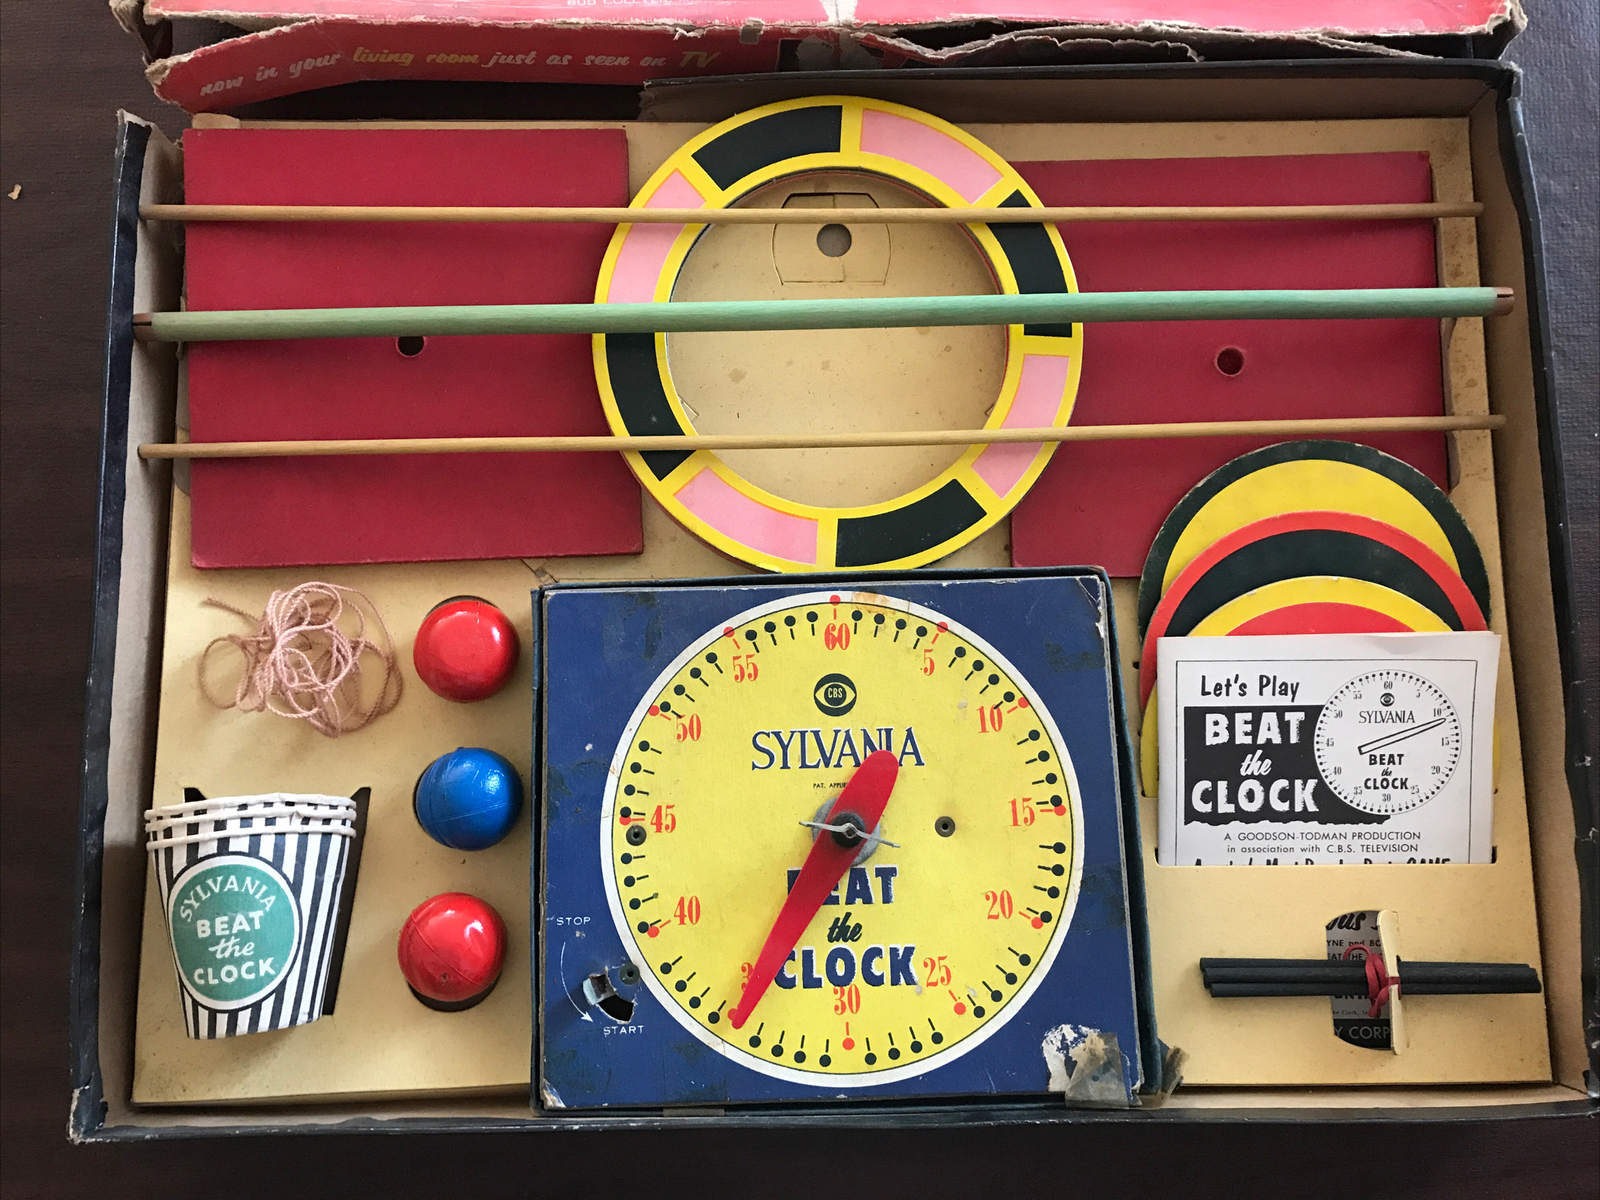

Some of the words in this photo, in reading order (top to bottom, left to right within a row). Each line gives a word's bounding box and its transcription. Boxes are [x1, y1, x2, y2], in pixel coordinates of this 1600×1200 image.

[200, 76, 243, 96] now
[256, 65, 278, 82] in
[289, 51, 342, 79] your
[353, 46, 415, 67] living
[426, 52, 480, 64] room
[481, 51, 538, 68] just
[546, 54, 573, 66] as
[585, 53, 631, 67] seen
[640, 55, 667, 67] on
[678, 51, 721, 69] TV
[824, 622, 850, 651] 60
[732, 653, 759, 684] 55
[923, 648, 935, 676] 5
[827, 687, 844, 699] CBS
[1200, 673, 1247, 698] Let's
[1259, 674, 1300, 702] Play
[1353, 690, 1362, 700] 55
[1383, 681, 1393, 690] 60
[1416, 689, 1421, 698] 5
[976, 704, 1003, 734] 10
[1334, 710, 1343, 719] 50
[1359, 710, 1416, 724] SYLVANIA
[1433, 707, 1442, 717] 10
[676, 714, 702, 743] 50
[1205, 711, 1306, 746] BEAT
[752, 726, 926, 771] SYLVANIA
[1325, 737, 1335, 747] 45
[1441, 737, 1450, 747] 15
[1240, 750, 1272, 776] the
[1333, 766, 1342, 775] 40
[1369, 753, 1405, 766] BEAT
[1431, 765, 1441, 775] 20
[1364, 778, 1409, 790] CLOCK
[1381, 767, 1392, 777] the
[812, 782, 826, 790] PAT.
[1191, 779, 1319, 814] CLOCK
[1353, 786, 1363, 796] 35
[1382, 793, 1391, 803] 30
[1410, 785, 1420, 795] 25
[650, 804, 676, 833] 45
[1008, 797, 1035, 827] 15
[1224, 832, 1232, 841] A
[1238, 831, 1348, 841] GOODSON-TODMAN
[1352, 831, 1421, 840] PRODUCTION
[1227, 844, 1236, 853] in
[1241, 844, 1295, 853] association
[1300, 844, 1320, 853] with
[1326, 844, 1355, 853] C.B.S.
[1360, 843, 1418, 853] TELEVISION
[180, 874, 277, 922] SYLVANIA
[984, 889, 1013, 920] 20
[556, 916, 591, 927] STOP
[673, 895, 701, 926] 40
[196, 910, 265, 938] BEAT
[827, 911, 862, 943] the
[208, 935, 255, 959] the
[193, 956, 277, 985] CLOCK
[774, 944, 919, 989] CLOCK
[923, 955, 951, 988] 25
[833, 983, 861, 1016] 30
[603, 1025, 644, 1038] START
